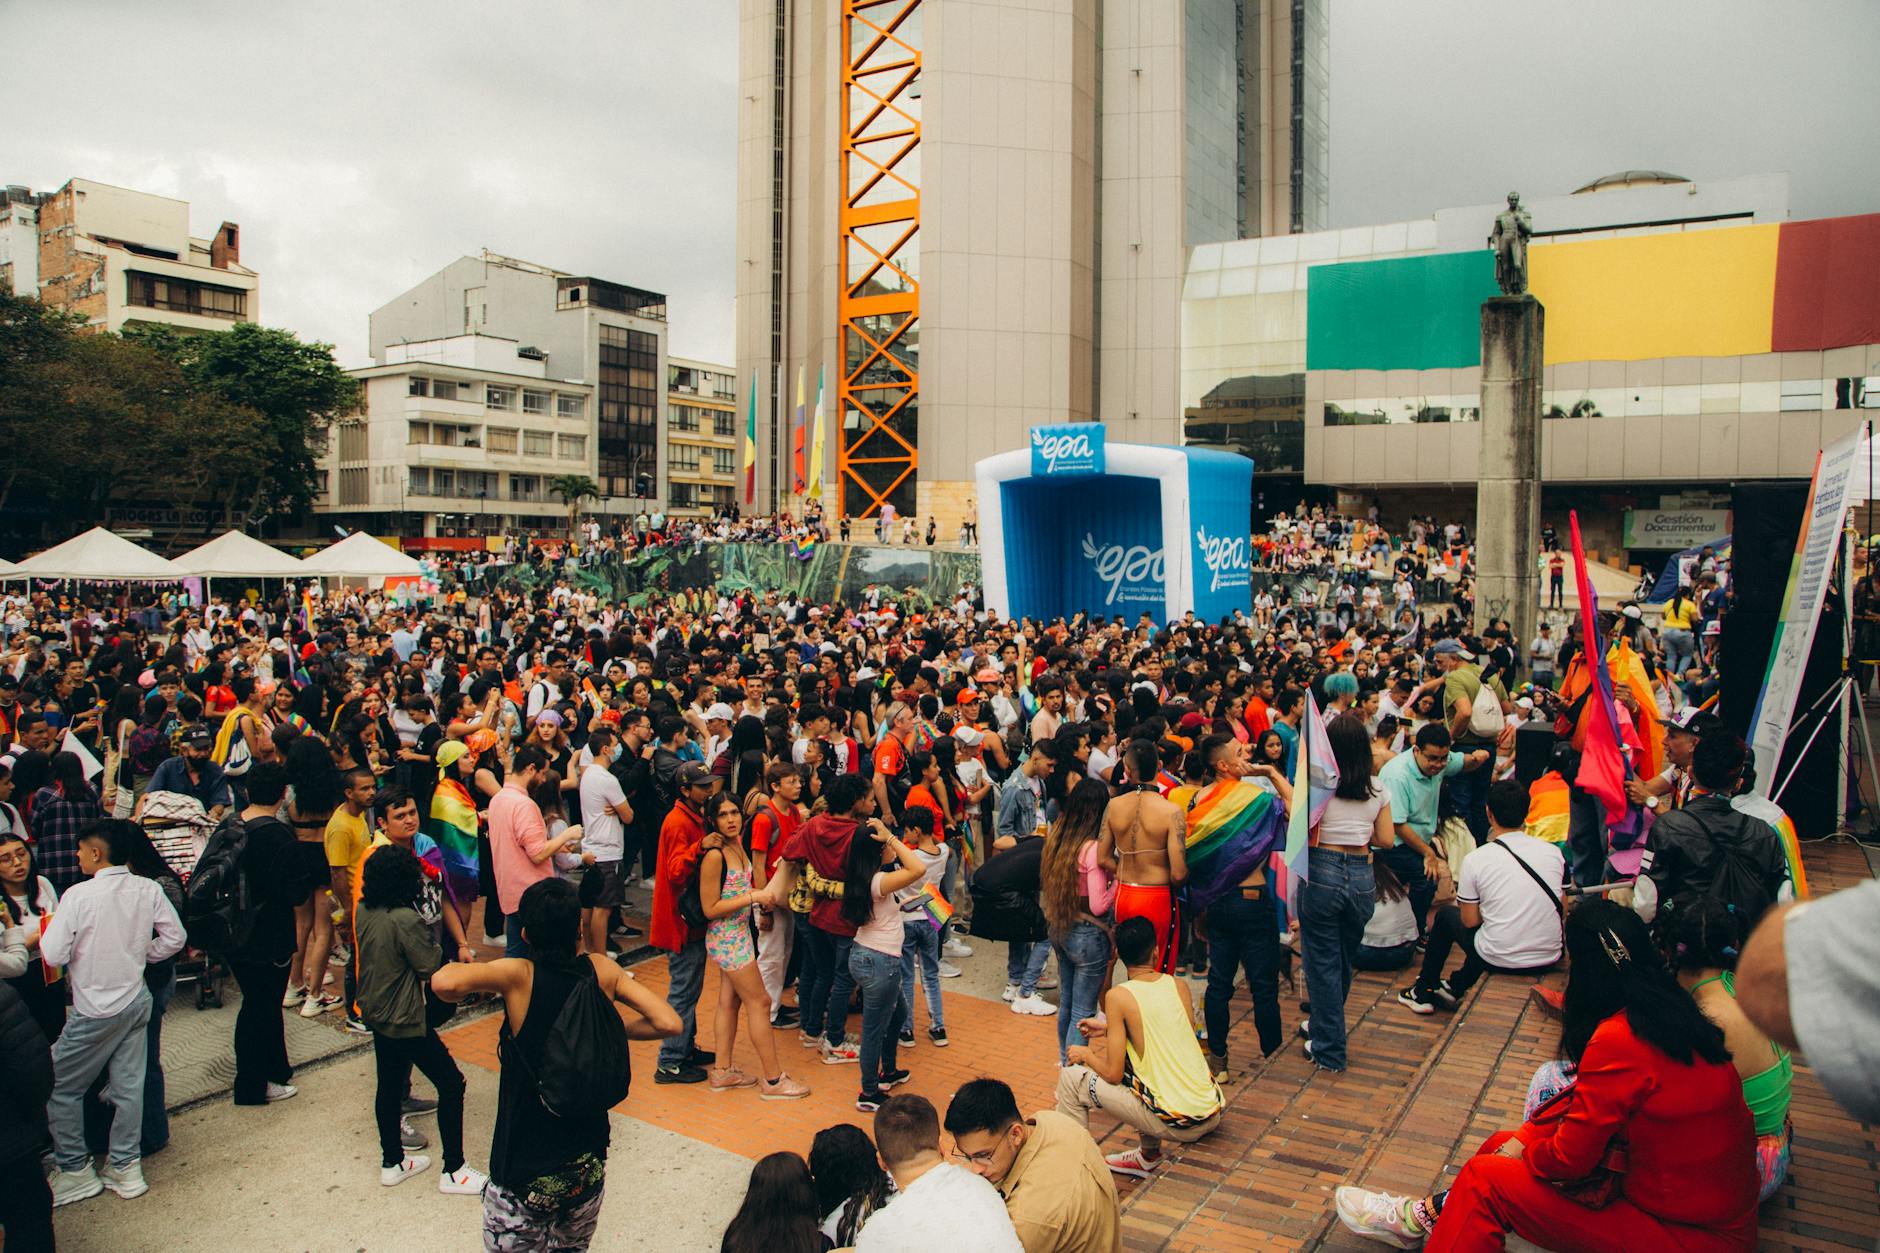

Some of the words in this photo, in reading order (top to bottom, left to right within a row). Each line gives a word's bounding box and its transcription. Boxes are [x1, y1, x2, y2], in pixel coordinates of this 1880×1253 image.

[1042, 434, 1094, 474] epa
[1644, 523, 1716, 532] Documental
[1654, 513, 1703, 524] Gestión
[1207, 536, 1249, 593] epa
